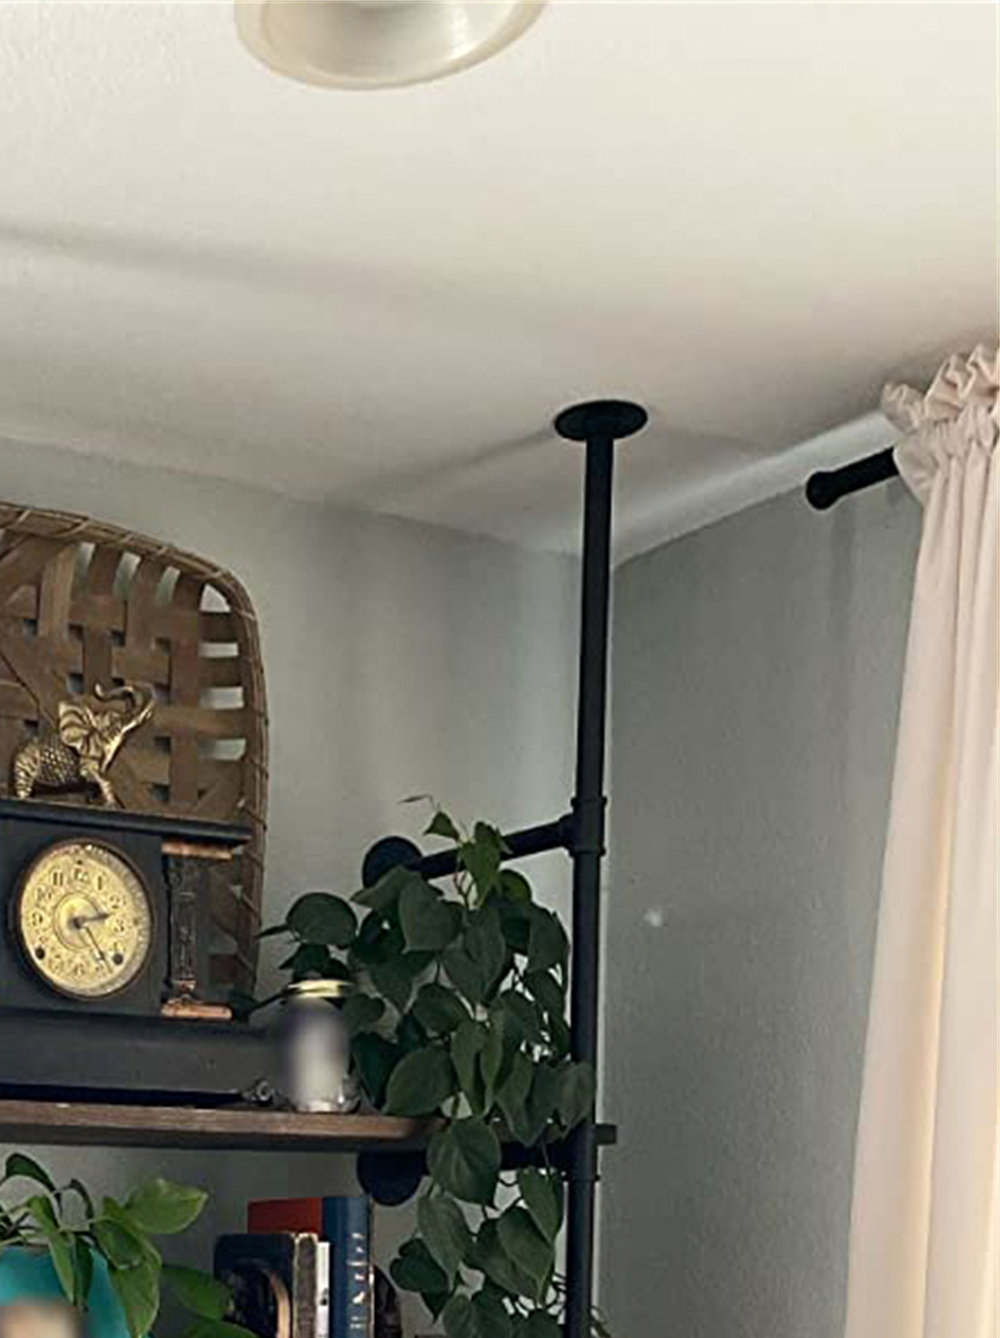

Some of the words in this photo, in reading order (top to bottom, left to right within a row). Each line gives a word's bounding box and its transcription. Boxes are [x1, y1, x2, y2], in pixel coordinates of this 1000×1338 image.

[52, 870, 64, 886] 11
[96, 874, 103, 891] 1
[109, 895, 121, 909] 2
[31, 911, 43, 926] 9
[113, 918, 125, 933] 3
